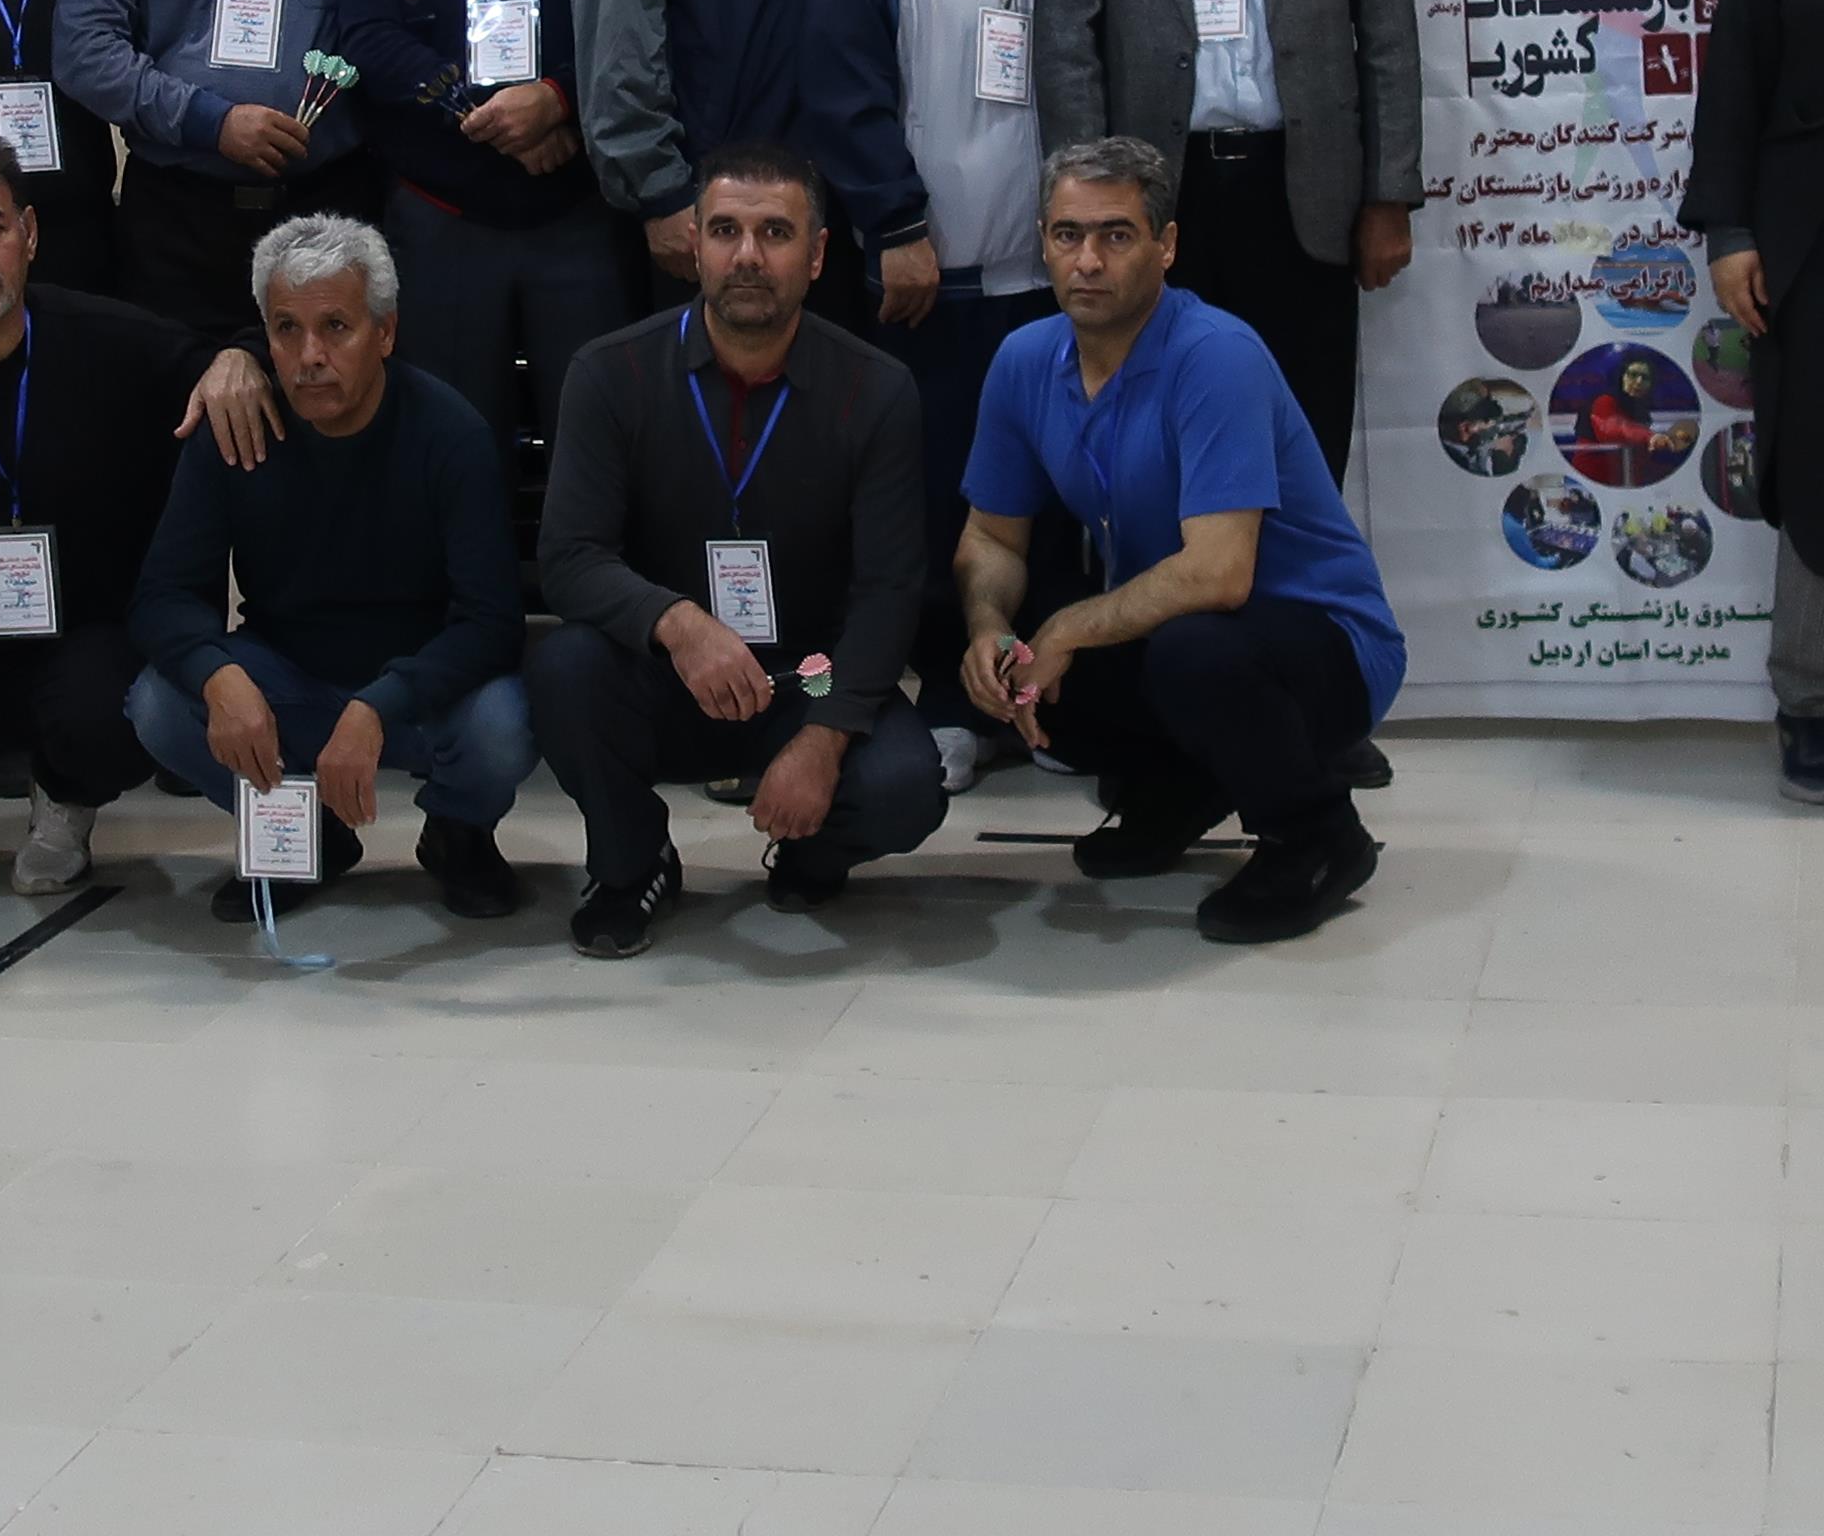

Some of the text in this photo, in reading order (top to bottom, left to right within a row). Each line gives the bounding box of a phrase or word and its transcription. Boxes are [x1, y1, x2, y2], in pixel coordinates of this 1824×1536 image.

[1468, 13, 1600, 97] کشوری
[1471, 126, 1536, 157] محترم
[1536, 119, 1620, 152] کنندگان
[1456, 170, 1572, 206] بازنشستگان
[1575, 170, 1647, 203] ورزشی
[1456, 221, 1515, 250] ۱۴۰۳
[1519, 222, 1552, 246] ماه
[1615, 222, 1642, 250] در
[1645, 218, 1705, 249] ردبیل
[1529, 269, 1697, 302] را گرامی میداریم
[1476, 601, 1564, 629] کشوری
[1568, 600, 1691, 629] بازنشستگی
[1528, 637, 1732, 667] مدیریت استان اردبیل
